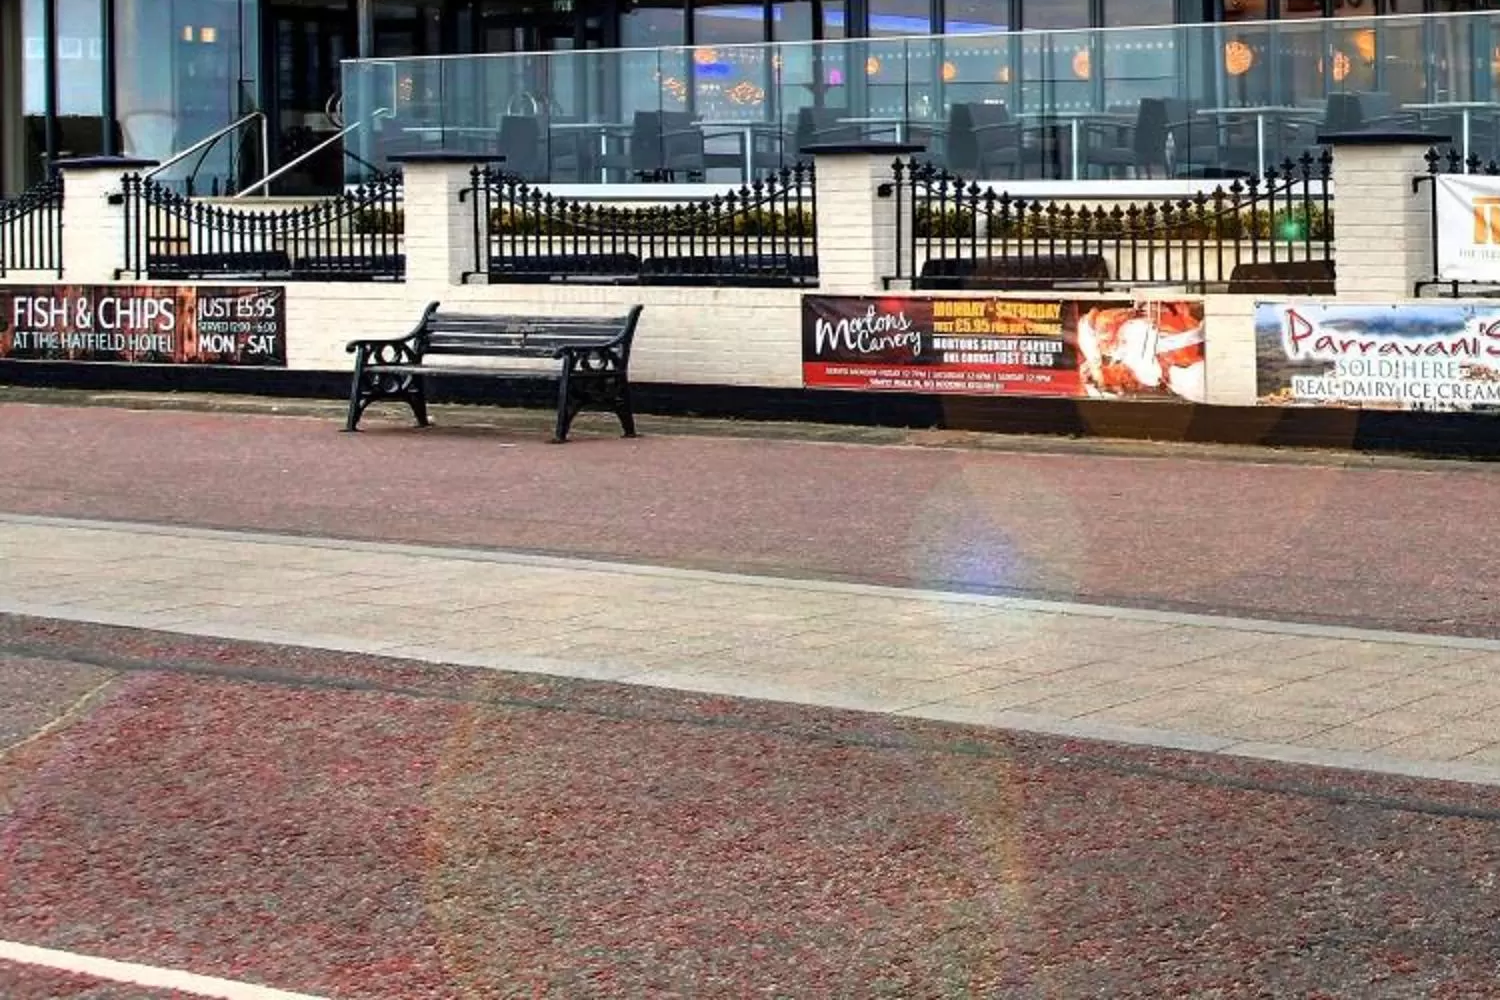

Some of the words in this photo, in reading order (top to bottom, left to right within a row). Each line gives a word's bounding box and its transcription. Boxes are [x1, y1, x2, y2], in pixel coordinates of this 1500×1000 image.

[13, 296, 68, 328] FISH
[75, 296, 93, 329] &
[98, 297, 175, 331] CHIPS
[198, 298, 233, 320] JUST
[237, 297, 276, 318] £5.95
[933, 301, 985, 317] MONDAY
[995, 303, 1061, 319] SATURDAY
[198, 321, 229, 333] SERVED
[815, 304, 912, 355] Mortons
[955, 318, 991, 333] £5.95
[13, 331, 28, 349] AT
[31, 332, 59, 350] THE
[61, 333, 125, 351] HATFIELD
[129, 333, 175, 353] HOTEL
[198, 334, 235, 354] MON
[248, 335, 276, 355] SAT
[858, 330, 921, 357] Carvery
[1338, 359, 1393, 378] SOLD
[1403, 360, 1457, 379] HERE
[1295, 380, 1337, 395] REAL
[1343, 380, 1396, 397] DAIRY
[1403, 382, 1431, 399] ICE
